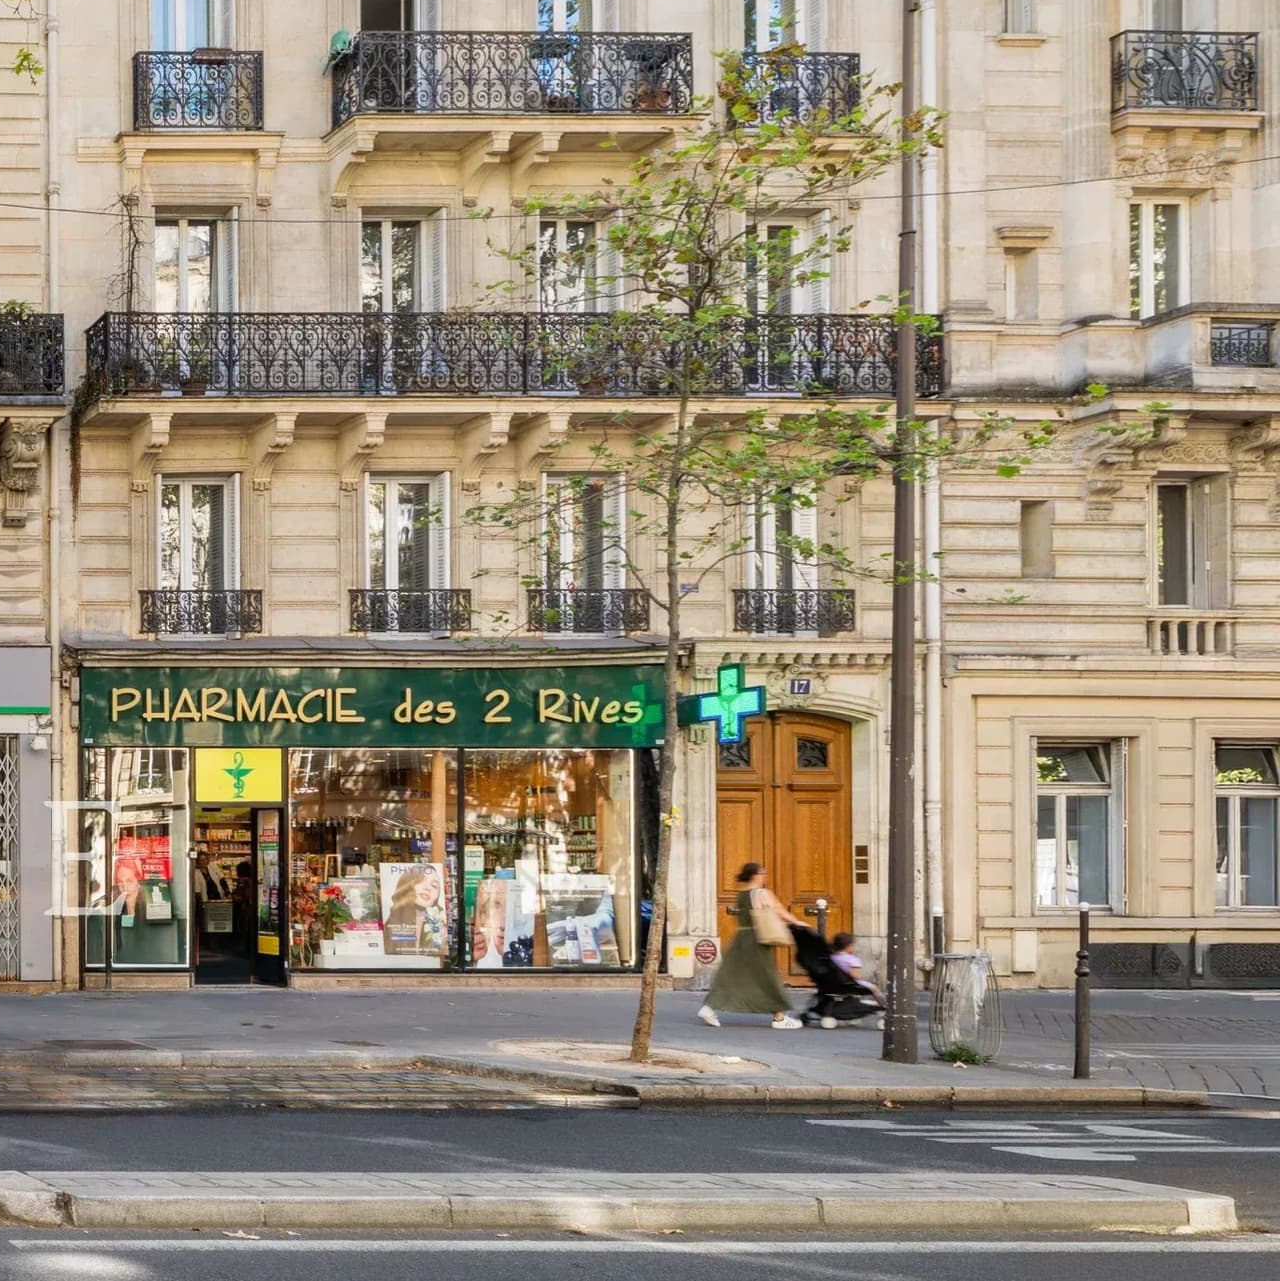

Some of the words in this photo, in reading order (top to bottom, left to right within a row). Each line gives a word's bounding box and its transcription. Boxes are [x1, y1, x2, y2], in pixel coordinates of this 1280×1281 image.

[793, 680, 809, 693] 17
[111, 686, 366, 724] PHARMACIE
[393, 686, 457, 725] des
[483, 688, 512, 724] 2
[538, 686, 644, 725] Rives
[391, 865, 433, 875] PHYTO
